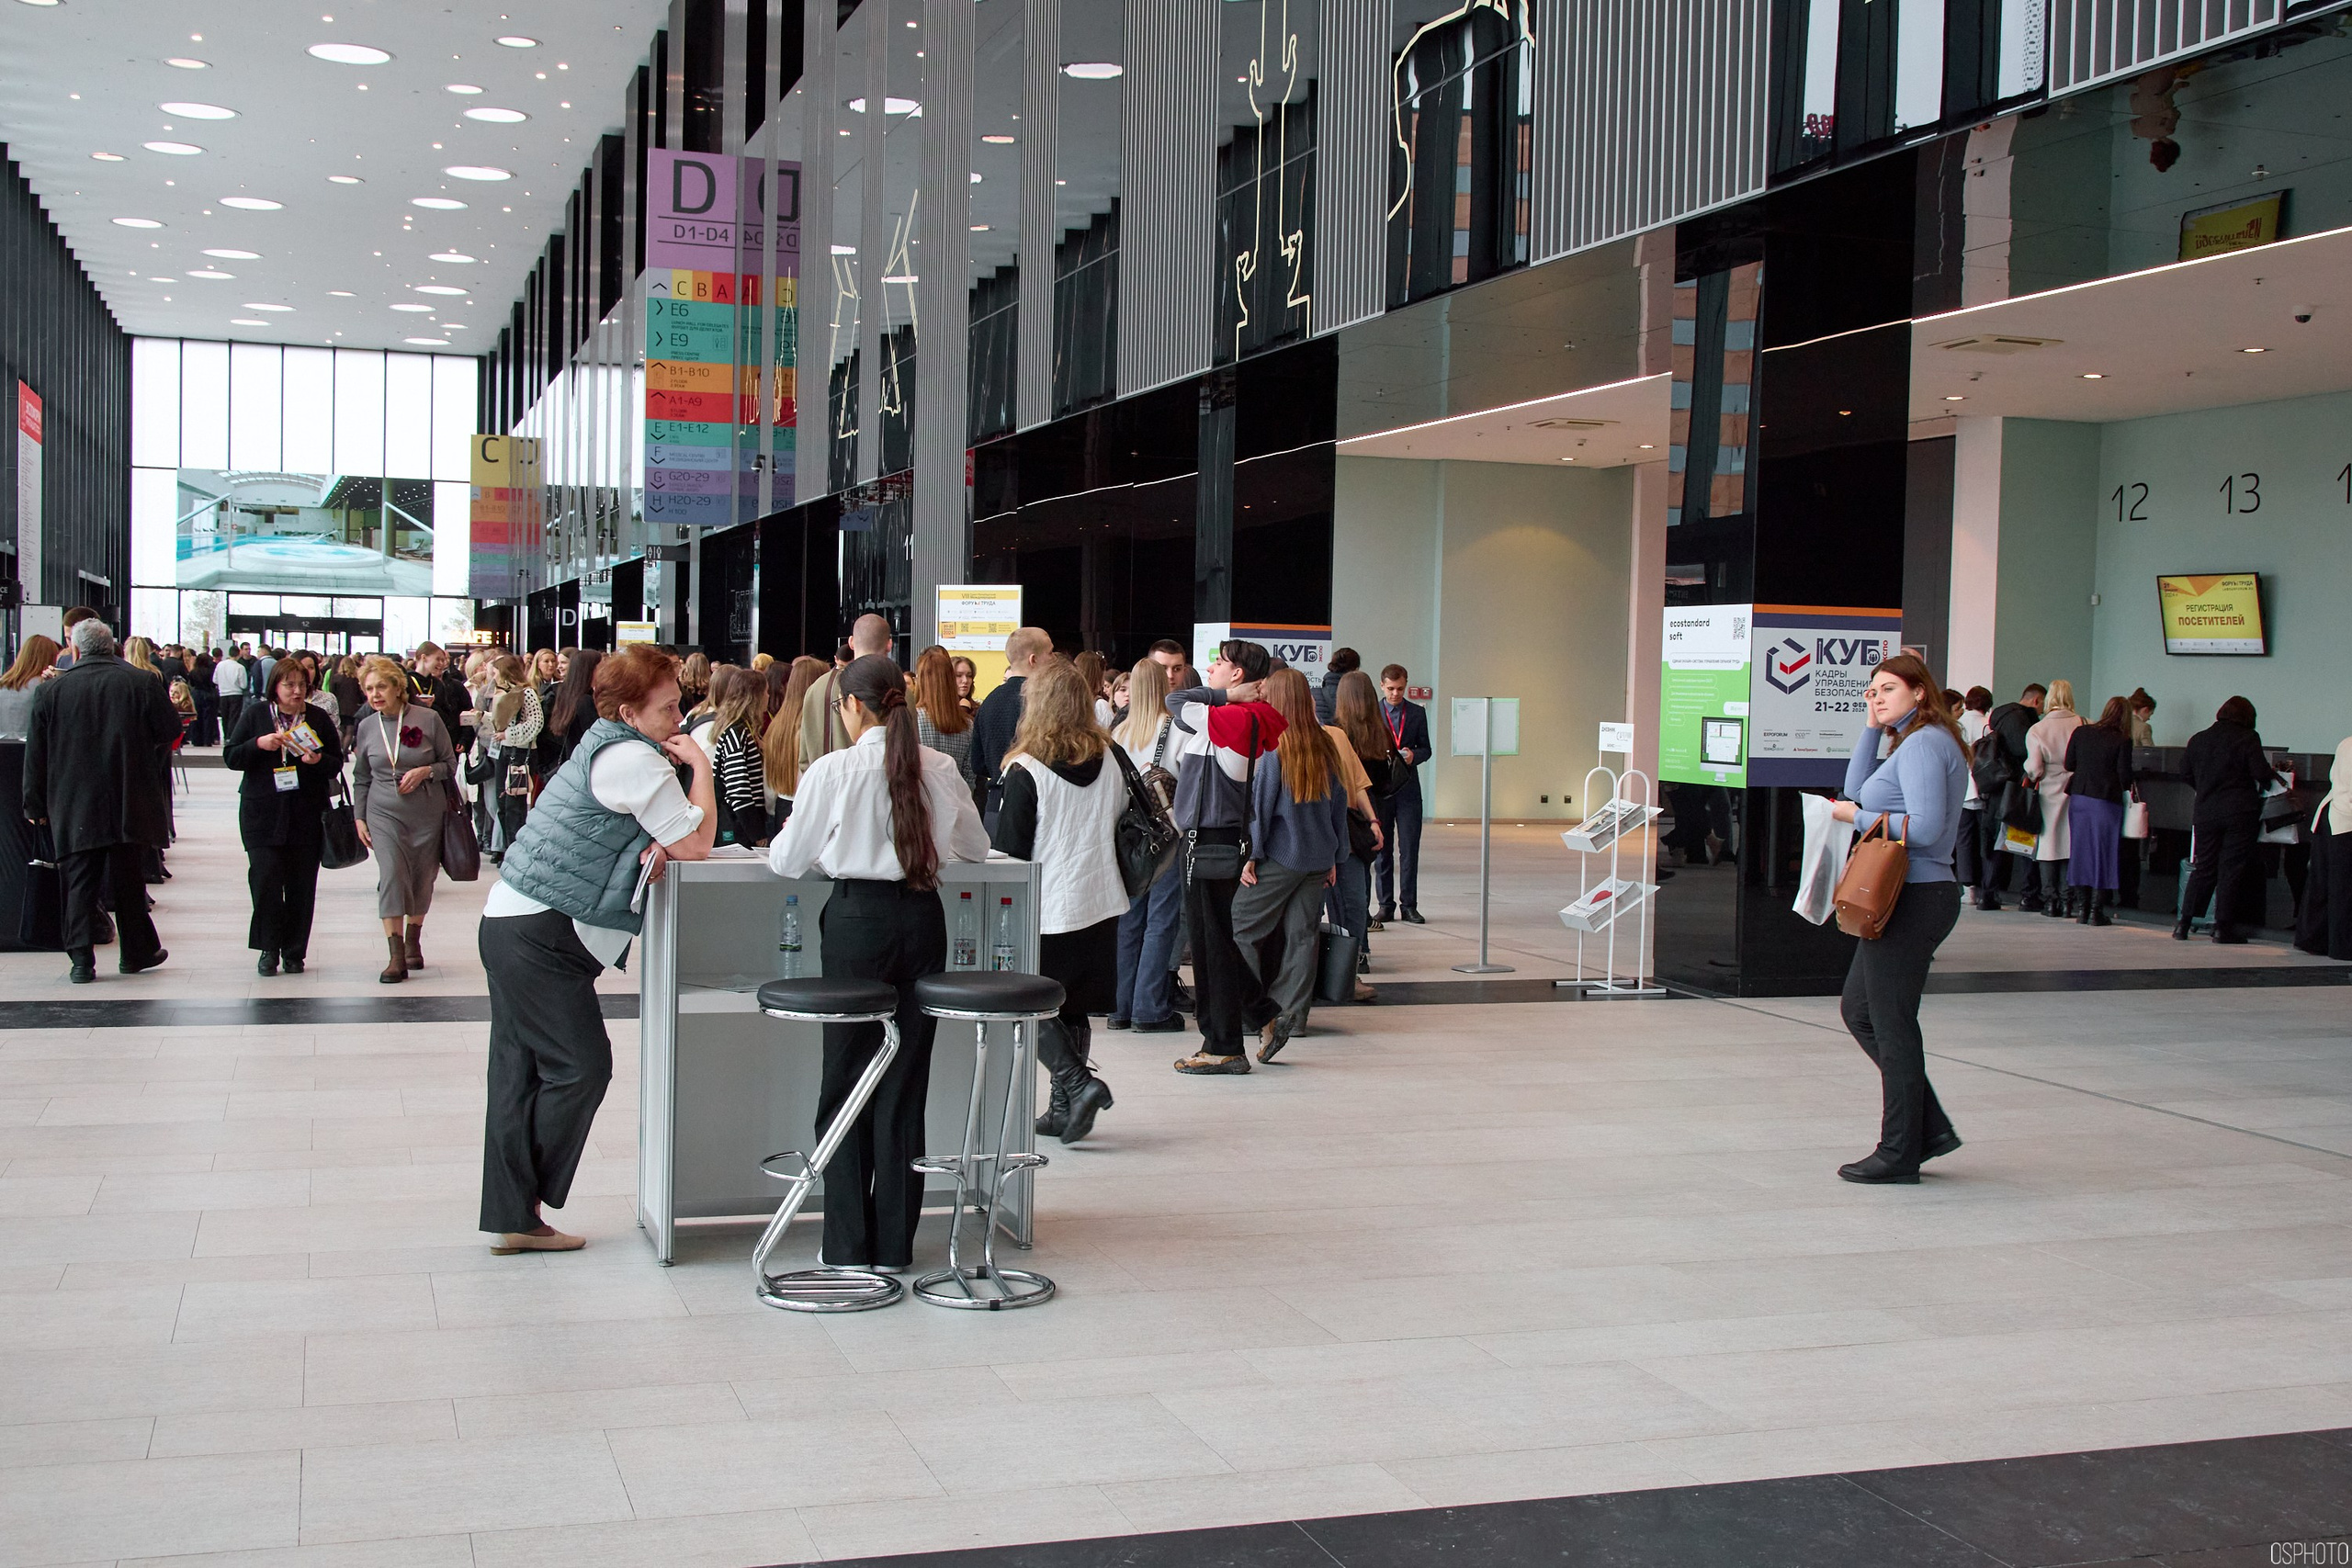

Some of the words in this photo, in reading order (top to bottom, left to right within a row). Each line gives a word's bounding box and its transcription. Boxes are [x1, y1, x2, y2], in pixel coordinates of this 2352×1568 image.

[673, 159, 716, 214] D
[674, 224, 729, 243] D1-D4
[677, 281, 687, 296] C
[697, 282, 707, 297] B
[717, 284, 728, 299] A
[671, 302, 689, 317] E6
[670, 333, 689, 347] E9
[670, 366, 710, 378] B1-B10
[669, 396, 702, 406] A1-A9
[654, 422, 662, 433] E
[669, 423, 709, 434] E1-E12
[481, 436, 500, 463] C
[654, 446, 662, 457] F
[653, 471, 662, 483] G
[669, 471, 710, 482] G20-29
[2219, 472, 2261, 515] 13
[652, 495, 662, 505] H
[668, 495, 711, 506] H20-29
[2111, 482, 2149, 523] 12
[2186, 604, 2233, 613] РЕГИСТРАЦИЯ
[562, 609, 577, 626] D
[1669, 619, 1710, 628] ecostandard
[2178, 615, 2245, 626] ПОСЕТИТЕЛЕЙ
[1669, 632, 1683, 641] soft
[1273, 645, 1317, 662] КУБ
[1816, 638, 1881, 666] КУБ
[1815, 670, 1848, 678] КАДРЫ
[1815, 701, 1849, 712] 21-22
[1153, 744, 1164, 766] GUES
